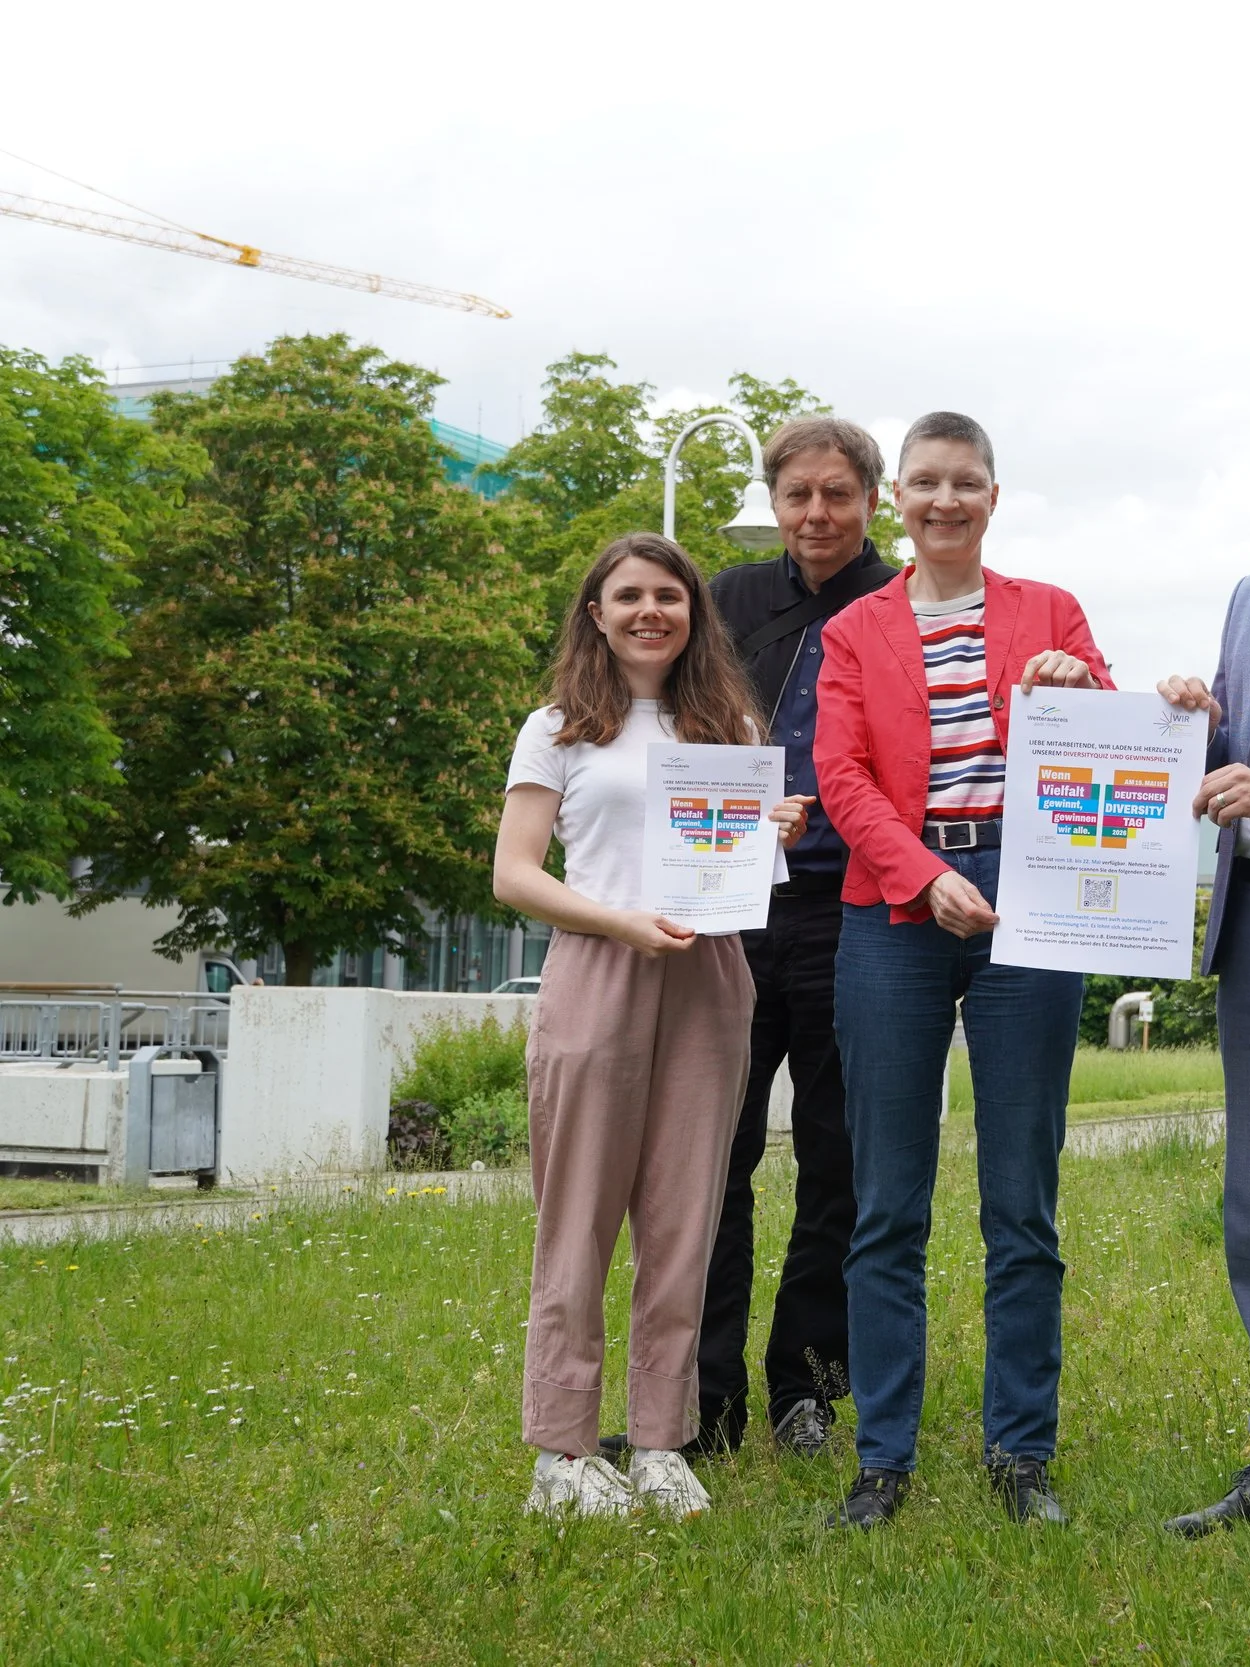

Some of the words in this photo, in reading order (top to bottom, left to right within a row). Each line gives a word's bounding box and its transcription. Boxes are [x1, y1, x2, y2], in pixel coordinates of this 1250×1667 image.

[1173, 715, 1190, 723] WIR
[1046, 741, 1097, 749] MITARBEITENDE,
[1063, 751, 1108, 759] DIVERSITYQUIZ
[1041, 769, 1071, 780] Wenn
[1042, 784, 1085, 797] Vielfalt
[1114, 791, 1166, 802] DEUTSCHER
[1043, 799, 1083, 811] gewinnt,
[1105, 803, 1164, 816] DIVERSITY
[673, 810, 703, 819] Vielfalt
[1054, 813, 1097, 823] gewinnen
[1123, 818, 1143, 827] TAG
[1058, 825, 1071, 833] wir
[1073, 826, 1090, 834] alle.
